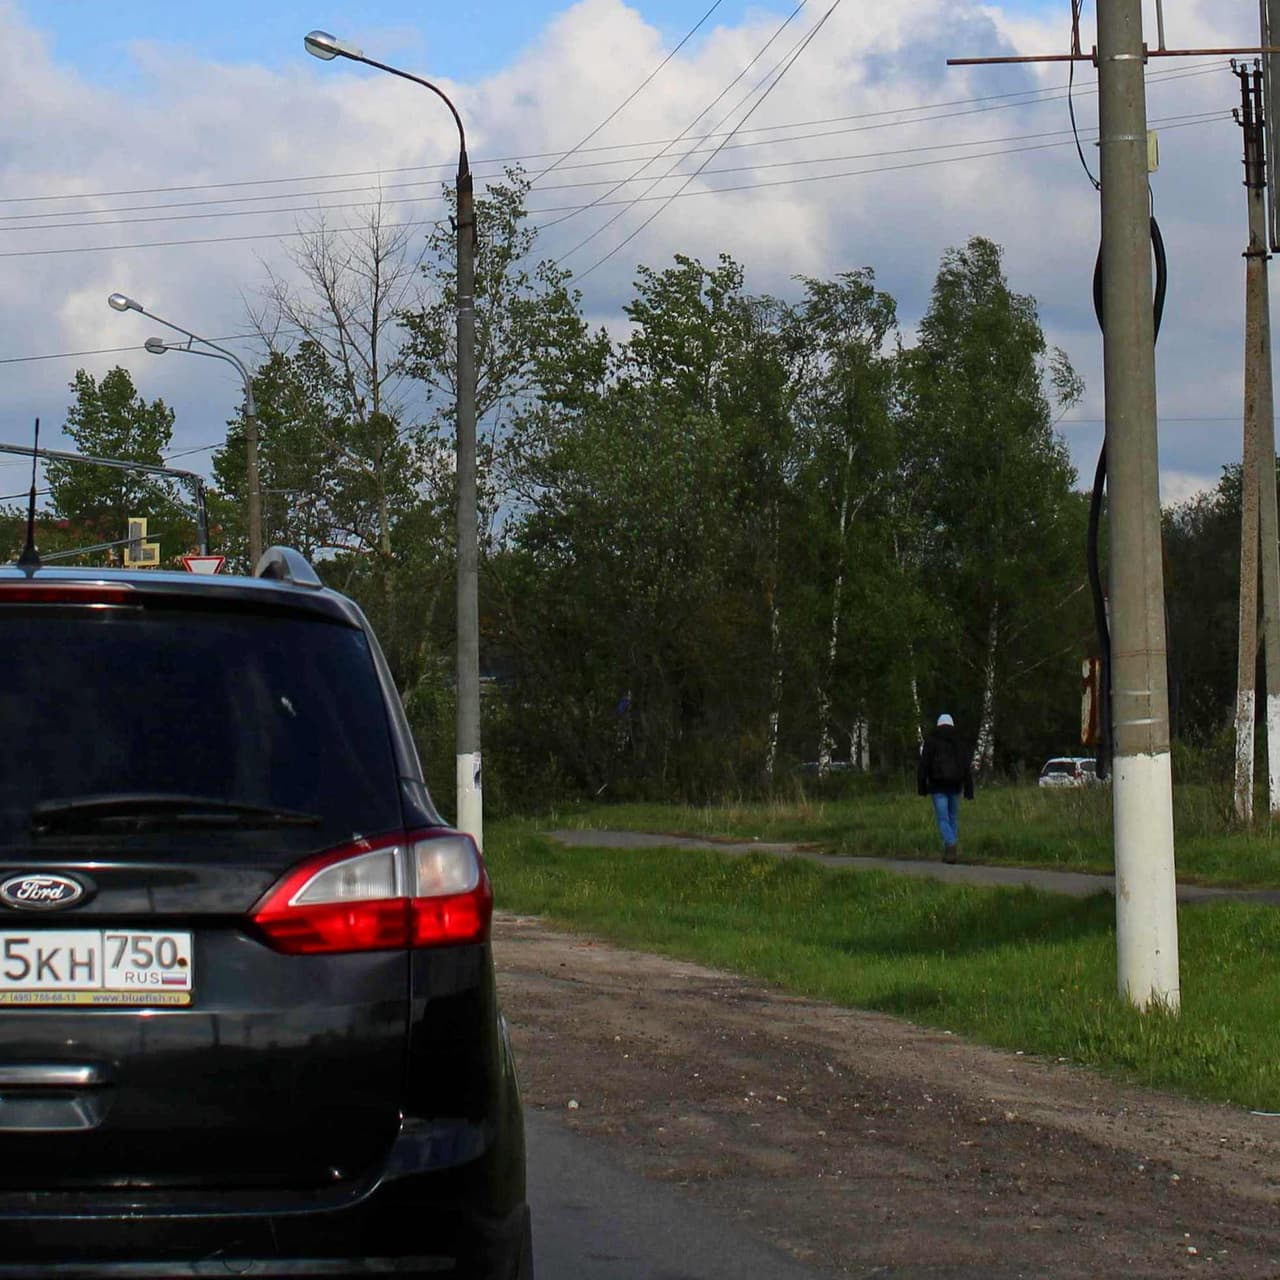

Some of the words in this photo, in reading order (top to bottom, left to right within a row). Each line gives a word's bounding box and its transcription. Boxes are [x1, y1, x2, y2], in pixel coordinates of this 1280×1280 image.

[16, 879, 65, 900] Ford
[106, 935, 179, 970] 750
[124, 971, 160, 984] RUS
